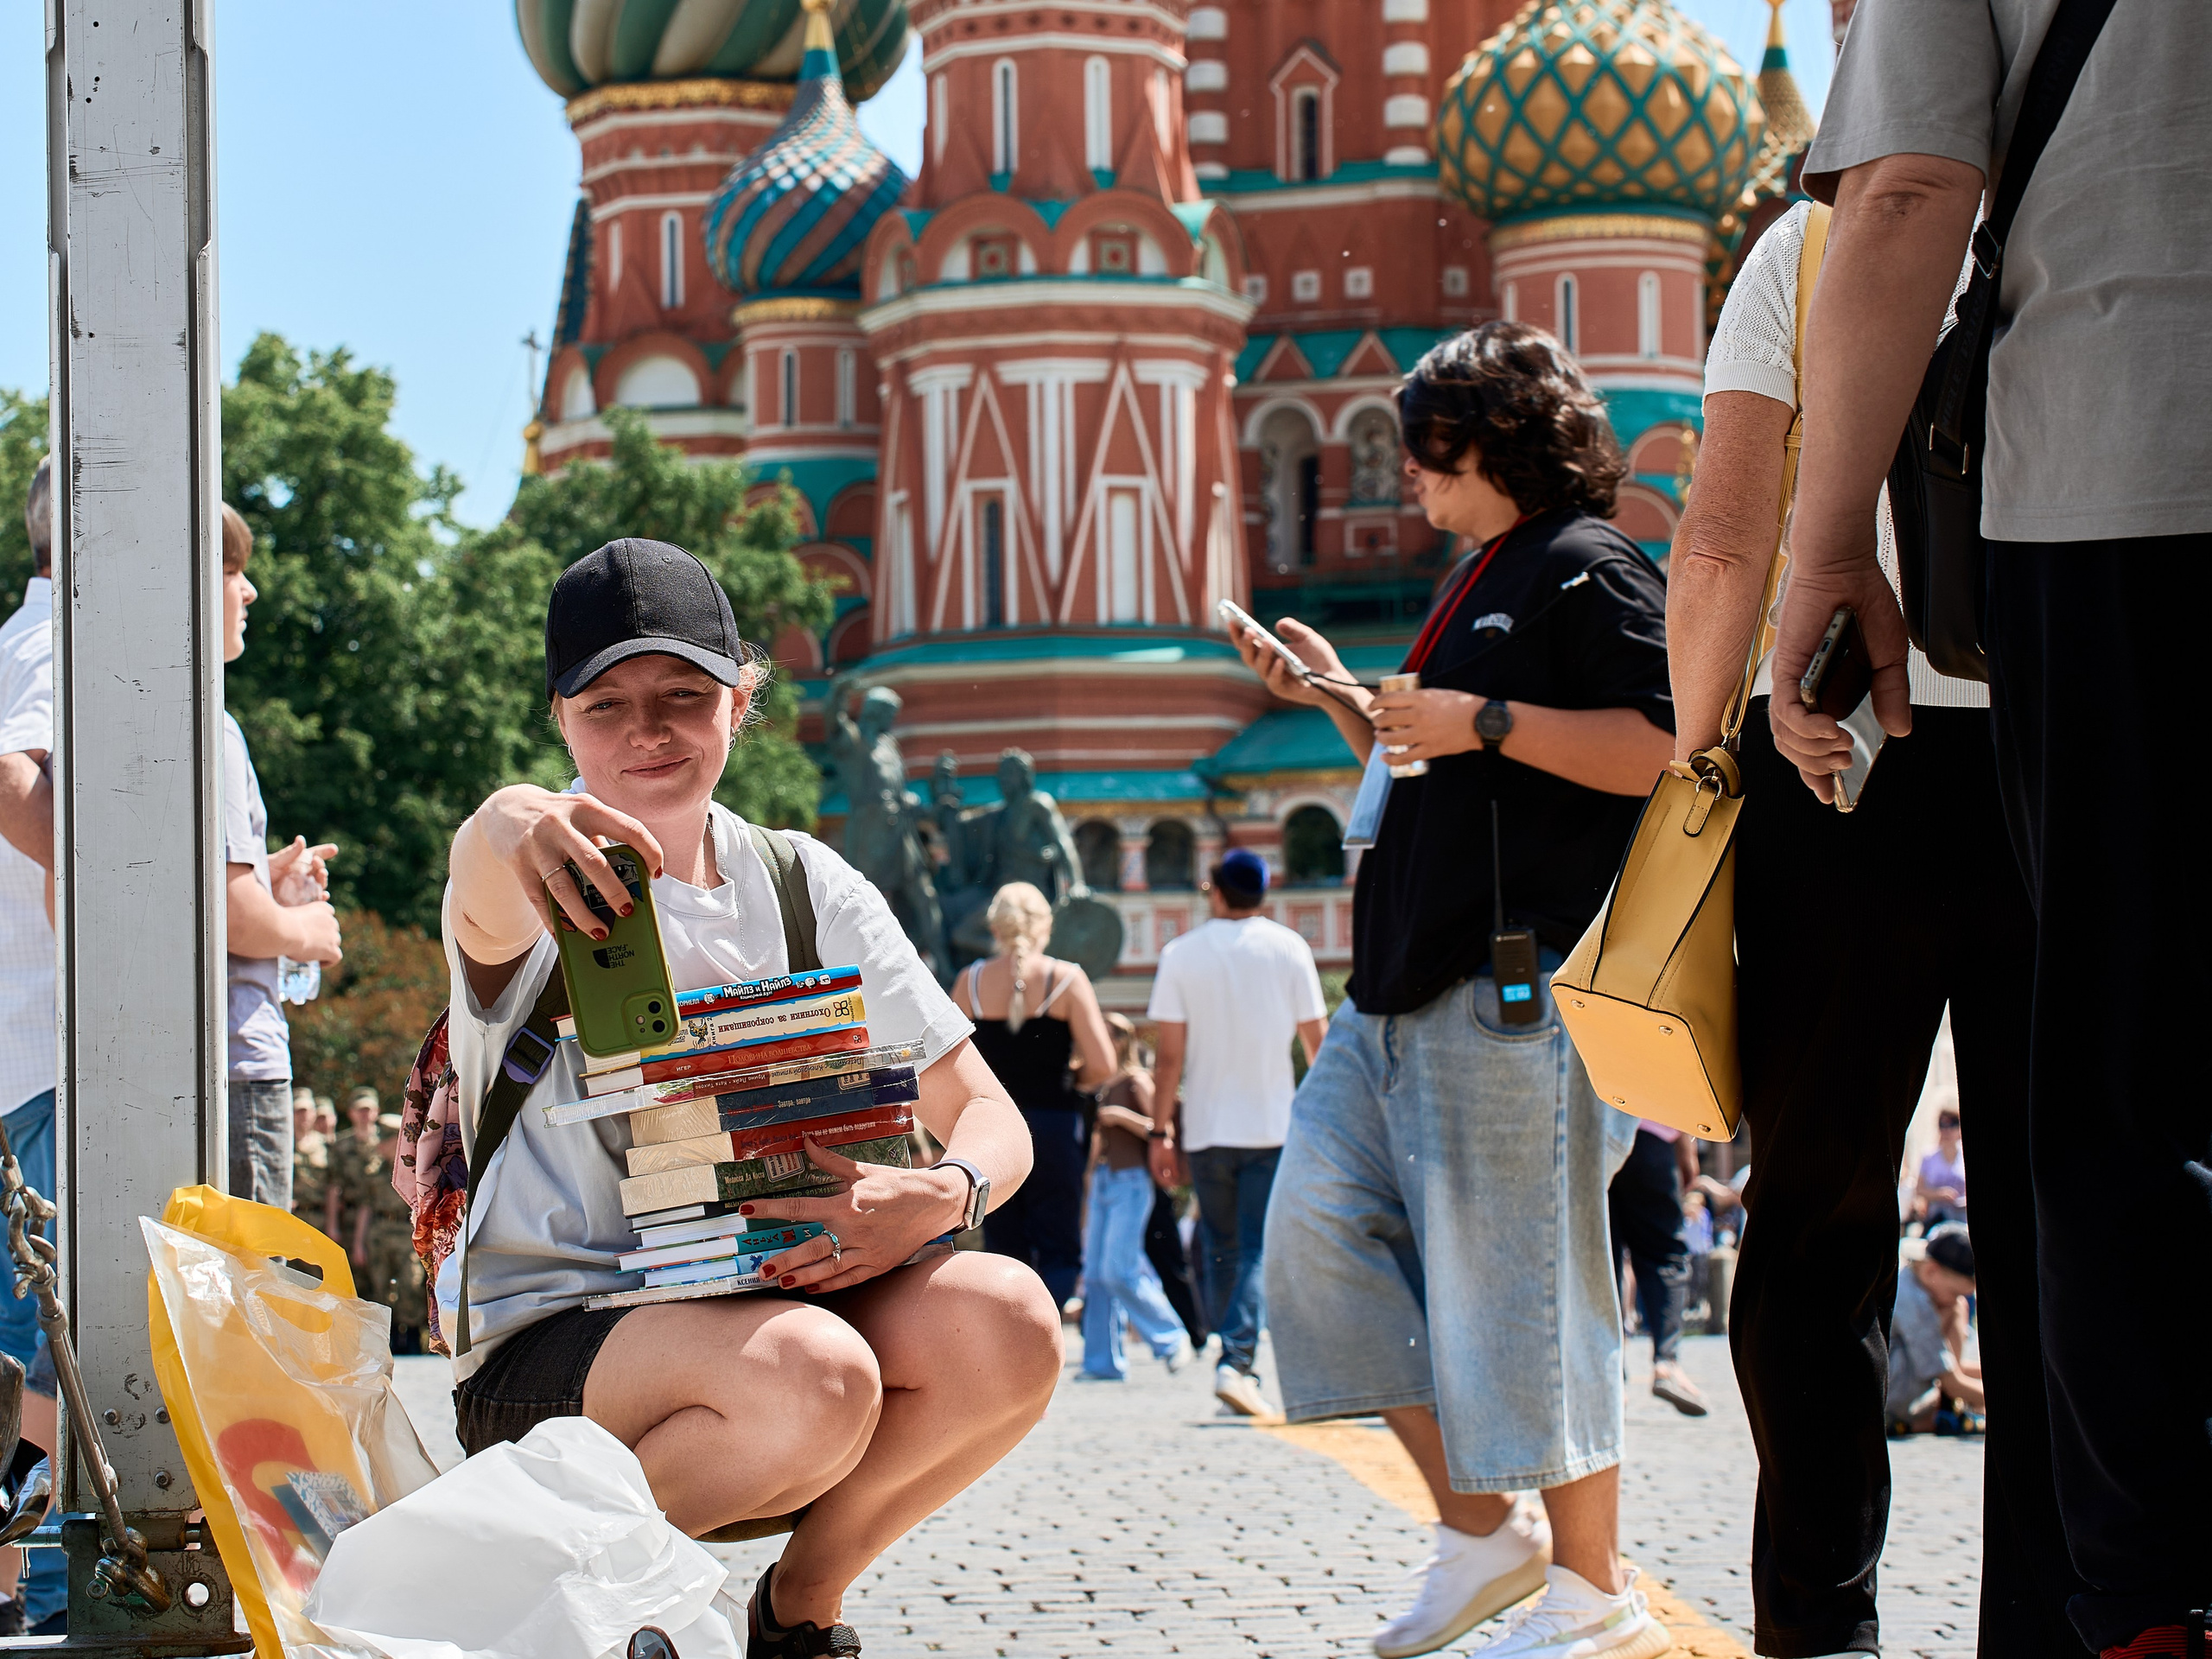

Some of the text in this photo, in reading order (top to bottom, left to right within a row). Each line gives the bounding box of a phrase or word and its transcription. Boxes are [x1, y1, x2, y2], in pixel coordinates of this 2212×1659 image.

[608, 950, 635, 961] NORTH
[609, 959, 626, 969] THE
[718, 1007, 831, 1033] Охотники за сокровищами
[741, 1232, 779, 1246] АНЬКА
[736, 1276, 760, 1286] КСЕНИЯ
